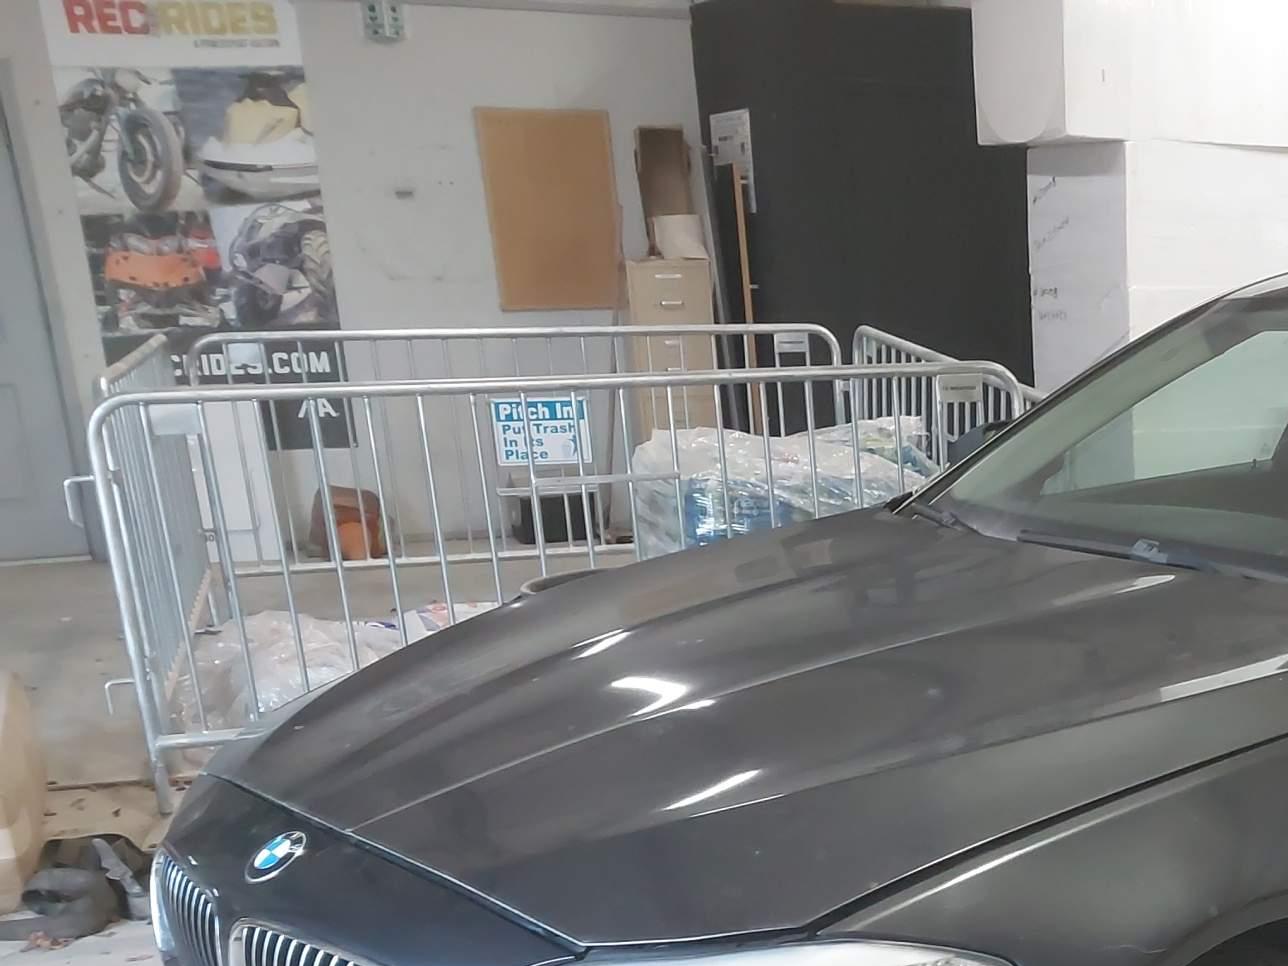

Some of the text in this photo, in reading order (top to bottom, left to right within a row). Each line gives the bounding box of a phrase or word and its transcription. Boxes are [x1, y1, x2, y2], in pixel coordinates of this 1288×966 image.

[556, 402, 574, 419] In
[502, 424, 526, 435] Pu
[503, 437, 518, 448] In
